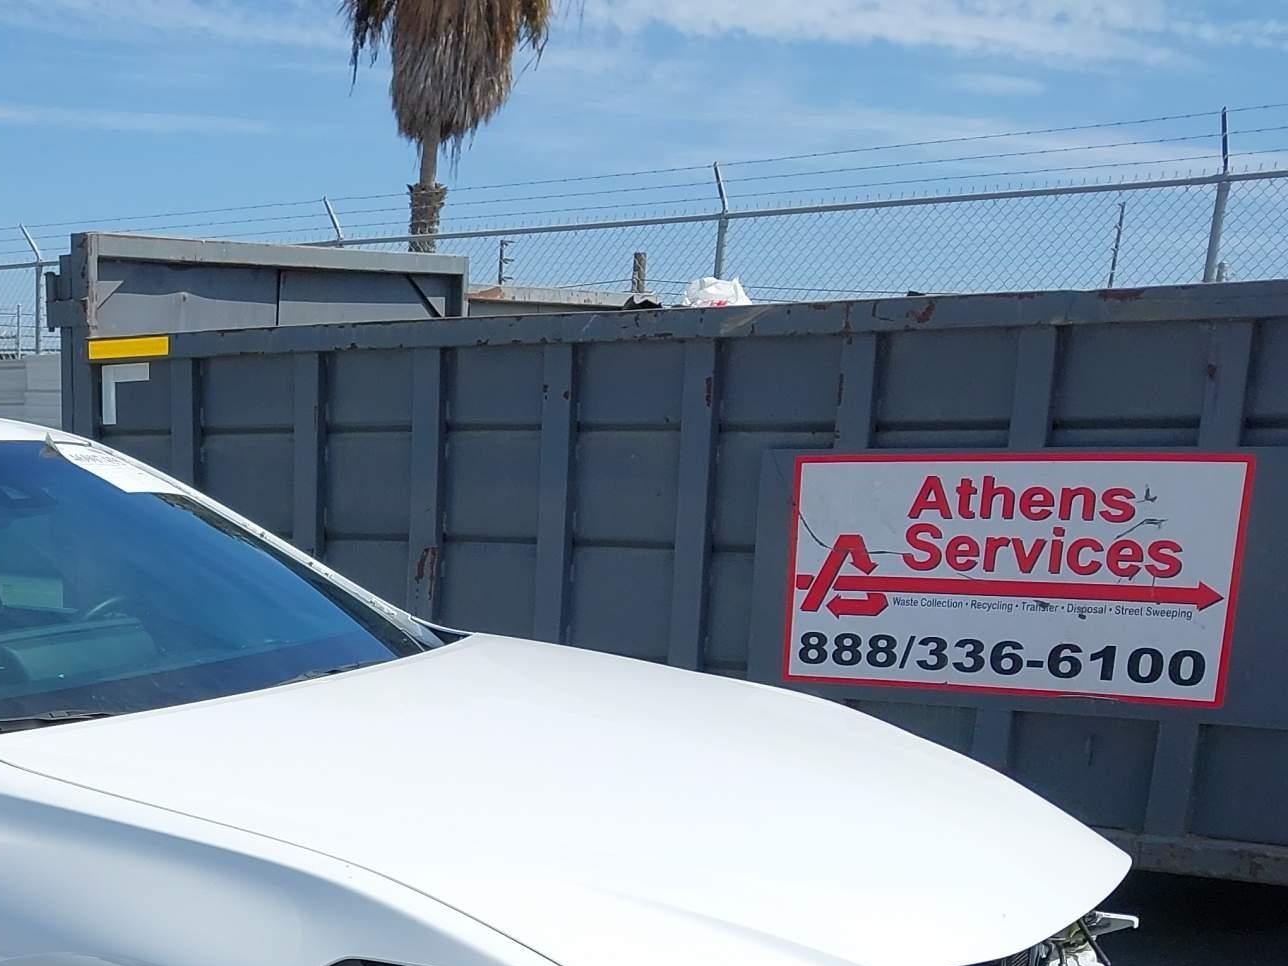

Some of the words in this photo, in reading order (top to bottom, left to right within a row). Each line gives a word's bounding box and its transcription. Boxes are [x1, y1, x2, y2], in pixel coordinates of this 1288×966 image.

[907, 475, 1136, 523] Athens
[903, 523, 1183, 578] Services
[893, 597, 919, 607] Waste
[920, 598, 963, 609] Collection
[970, 600, 1013, 613] Recycling
[1067, 604, 1107, 615] Disposal
[1114, 605, 1143, 617] Street
[1145, 607, 1193, 621] Sweeping
[798, 631, 1207, 687] 888/336-6100
